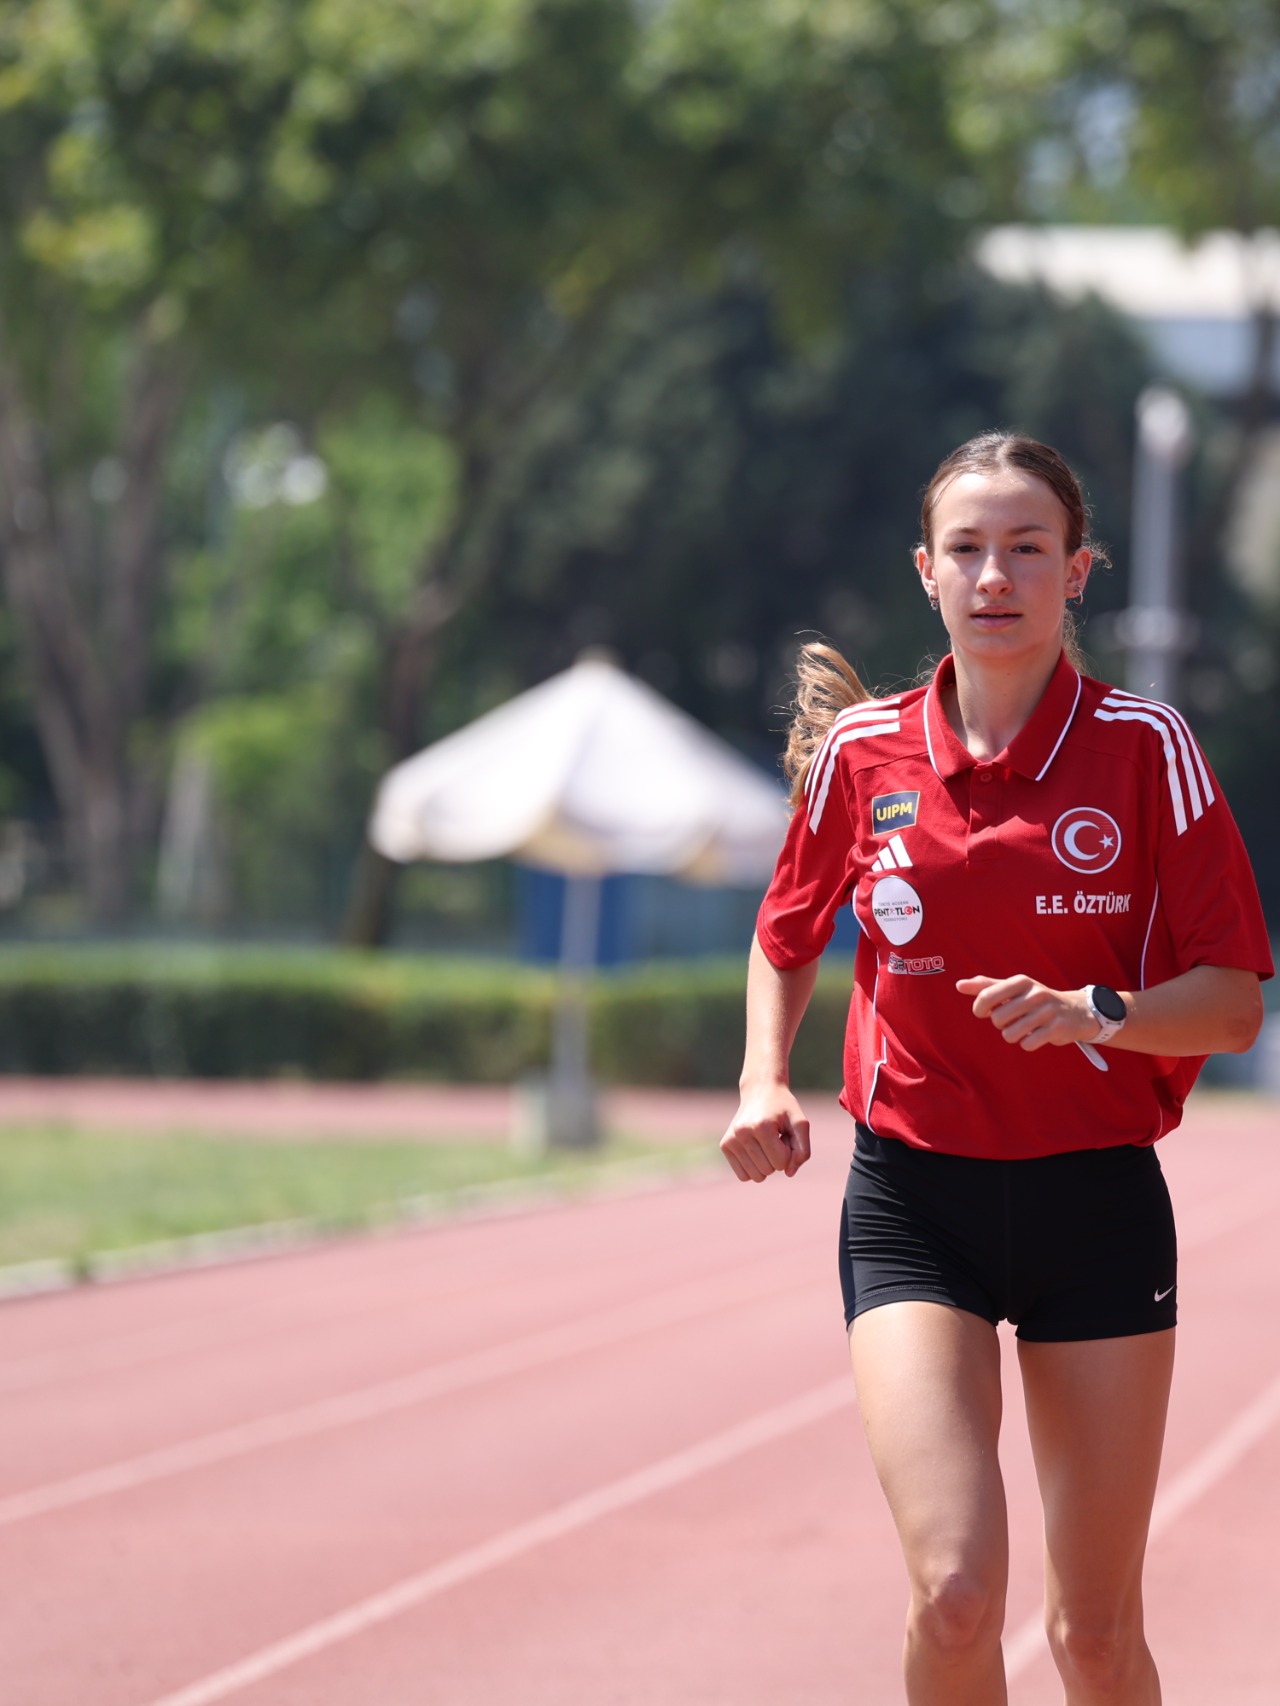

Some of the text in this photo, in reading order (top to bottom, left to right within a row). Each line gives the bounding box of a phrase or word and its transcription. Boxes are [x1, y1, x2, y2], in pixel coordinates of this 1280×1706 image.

[876, 801, 913, 821] UIPM
[1035, 890, 1132, 915] E.E. ÖZTÜRK
